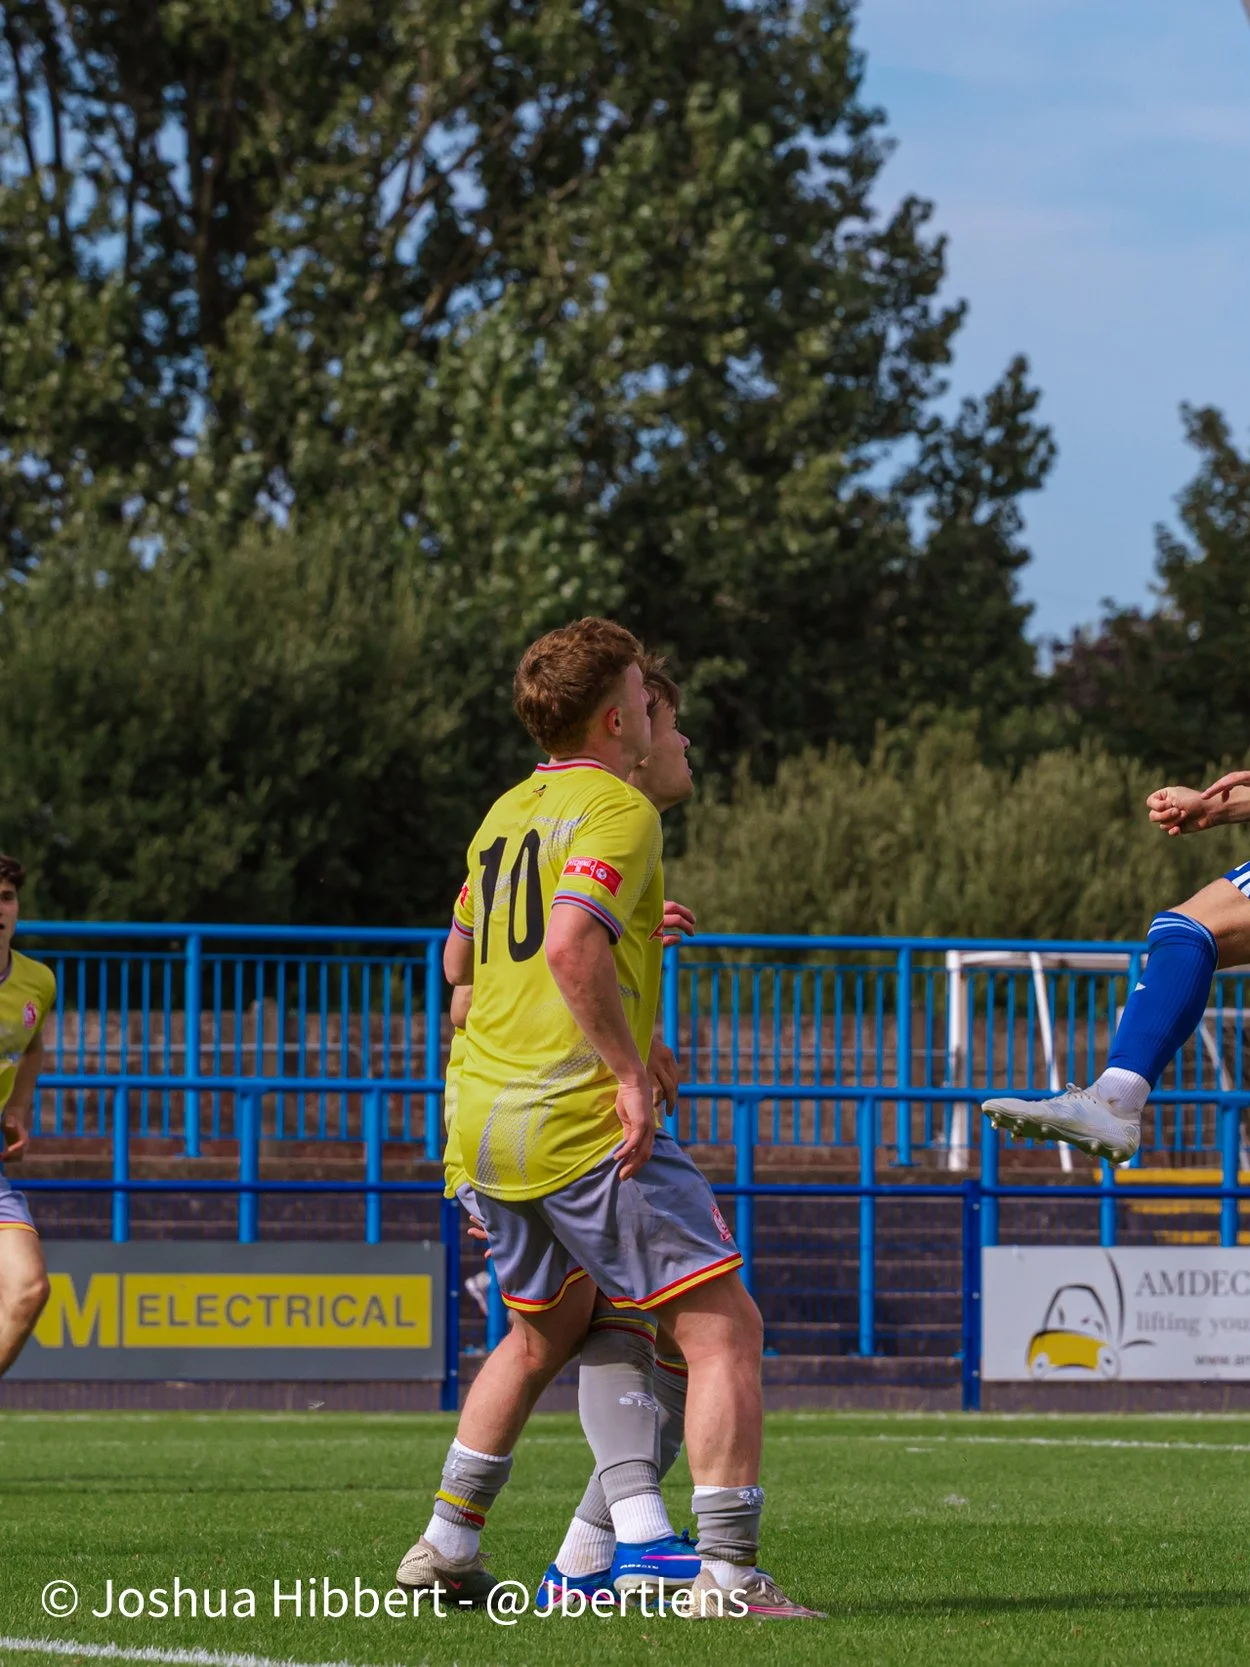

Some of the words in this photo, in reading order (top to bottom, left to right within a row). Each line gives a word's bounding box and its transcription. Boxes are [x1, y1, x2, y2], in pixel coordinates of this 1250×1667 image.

[479, 828, 544, 965] 10
[1134, 1270, 1250, 1297] AMDEC
[137, 1294, 416, 1329] ELECTRICAL
[1135, 1310, 1201, 1336] lifting
